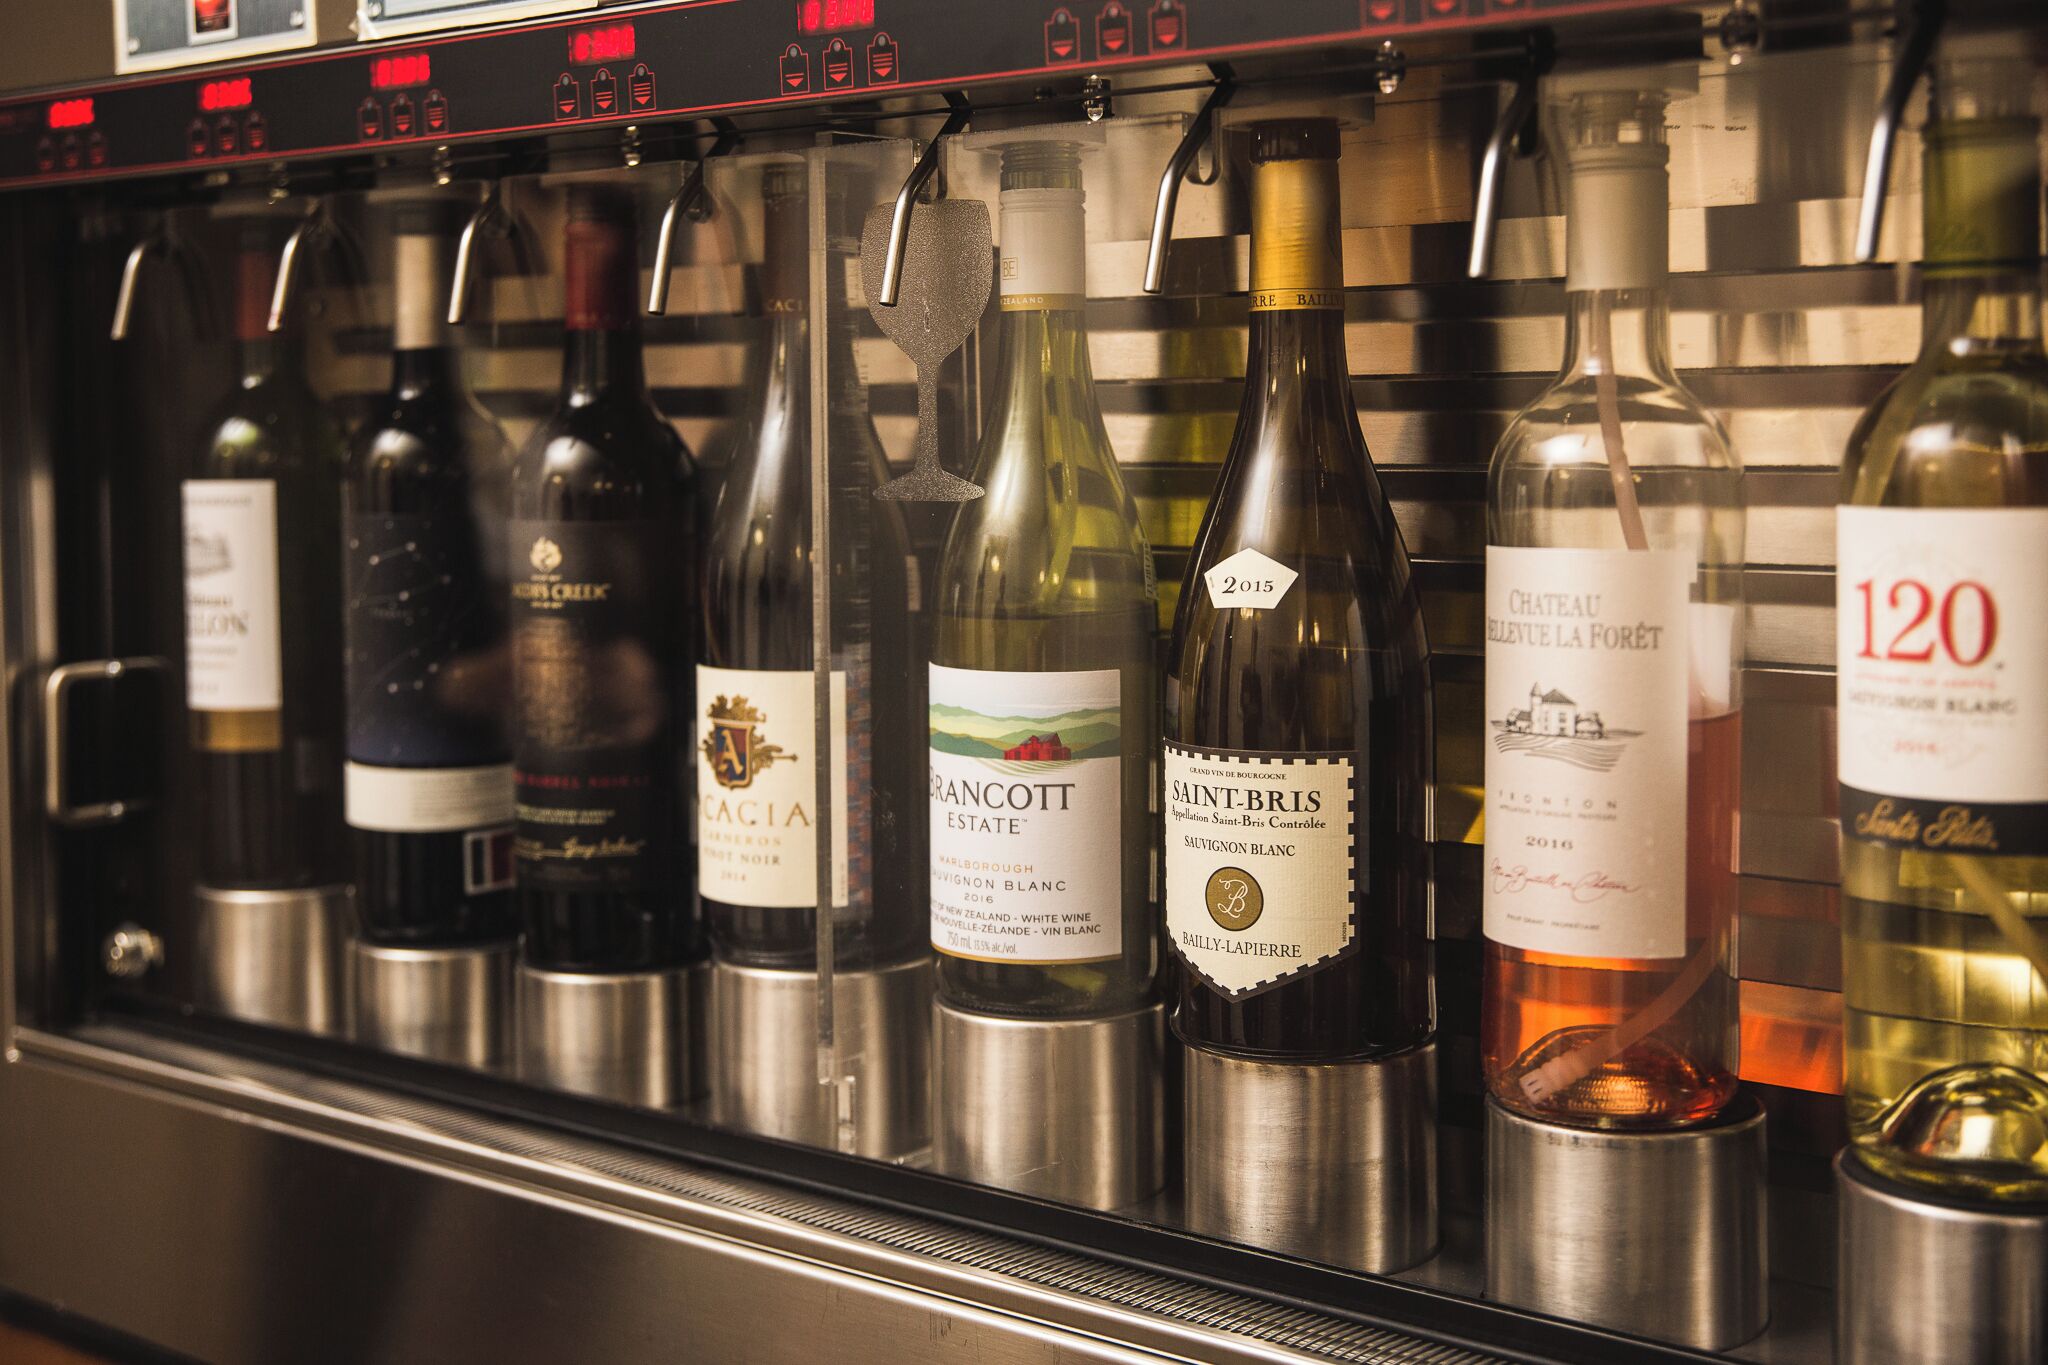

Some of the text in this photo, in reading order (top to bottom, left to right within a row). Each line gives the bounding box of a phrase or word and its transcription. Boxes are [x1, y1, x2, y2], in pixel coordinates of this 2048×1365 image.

[1248, 294, 1277, 308] RRE
[1222, 576, 1274, 594] 2015
[1509, 588, 1601, 619] CHATEAU
[1855, 578, 1998, 668] 120
[1556, 624, 1584, 648] LA
[1589, 620, 1664, 651] FORÊT
[1189, 767, 1210, 776] GRAND
[1211, 769, 1224, 777] VIN
[1237, 772, 1287, 780] BOURGOGNE
[1172, 779, 1321, 813] SAINT-BRIS
[1171, 804, 1326, 829] Appellation Saint-Bris Contrôlée
[1184, 835, 1296, 857] SAUVIGNON BLANC
[1525, 835, 1574, 851] 2016
[1004, 880, 1067, 892] BLANC
[964, 892, 994, 904] 2016
[946, 905, 963, 917] NEW
[964, 909, 1011, 923] ZEALAND
[1021, 914, 1058, 923] WHITE
[1061, 912, 1092, 922] WINE
[1041, 927, 1061, 936] VIN
[1064, 924, 1102, 936] BLANC
[1183, 931, 1302, 958] BAILLY-LAPIERRE
